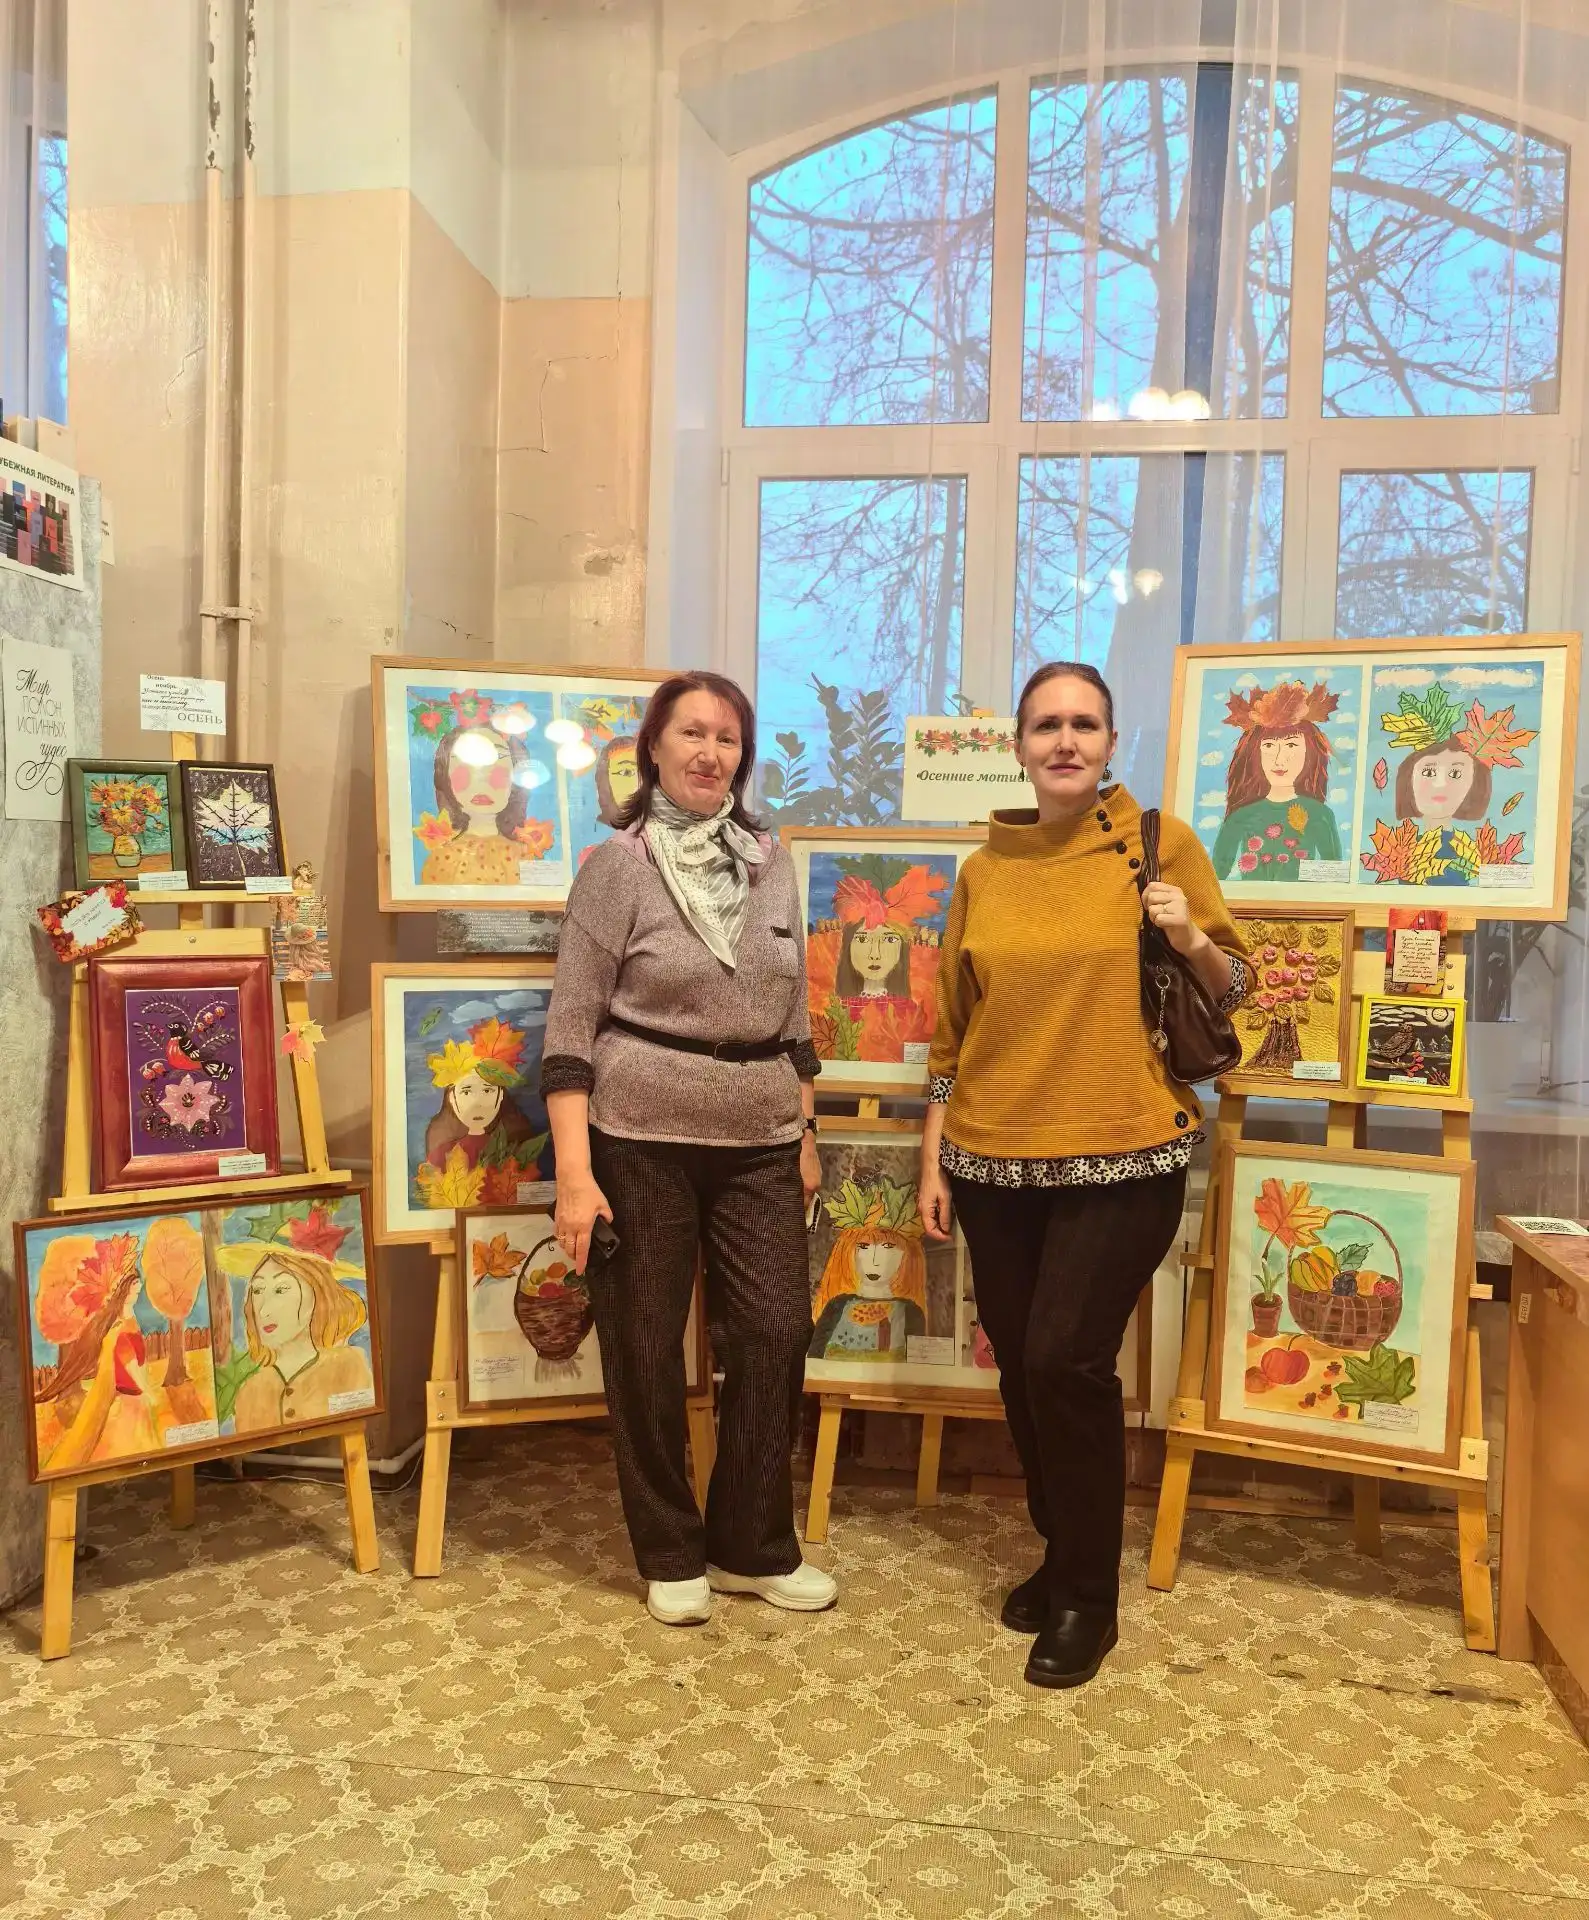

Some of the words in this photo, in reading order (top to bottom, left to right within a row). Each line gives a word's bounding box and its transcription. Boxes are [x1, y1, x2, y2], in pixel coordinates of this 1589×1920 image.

[37, 471, 75, 496] ЛИТЕРАТУРА
[16, 669, 51, 706] Мир
[23, 696, 62, 716] ПОЛОН
[18, 716, 67, 738] ИСТИННЫХ
[178, 713, 222, 724] ОСЕНЬ
